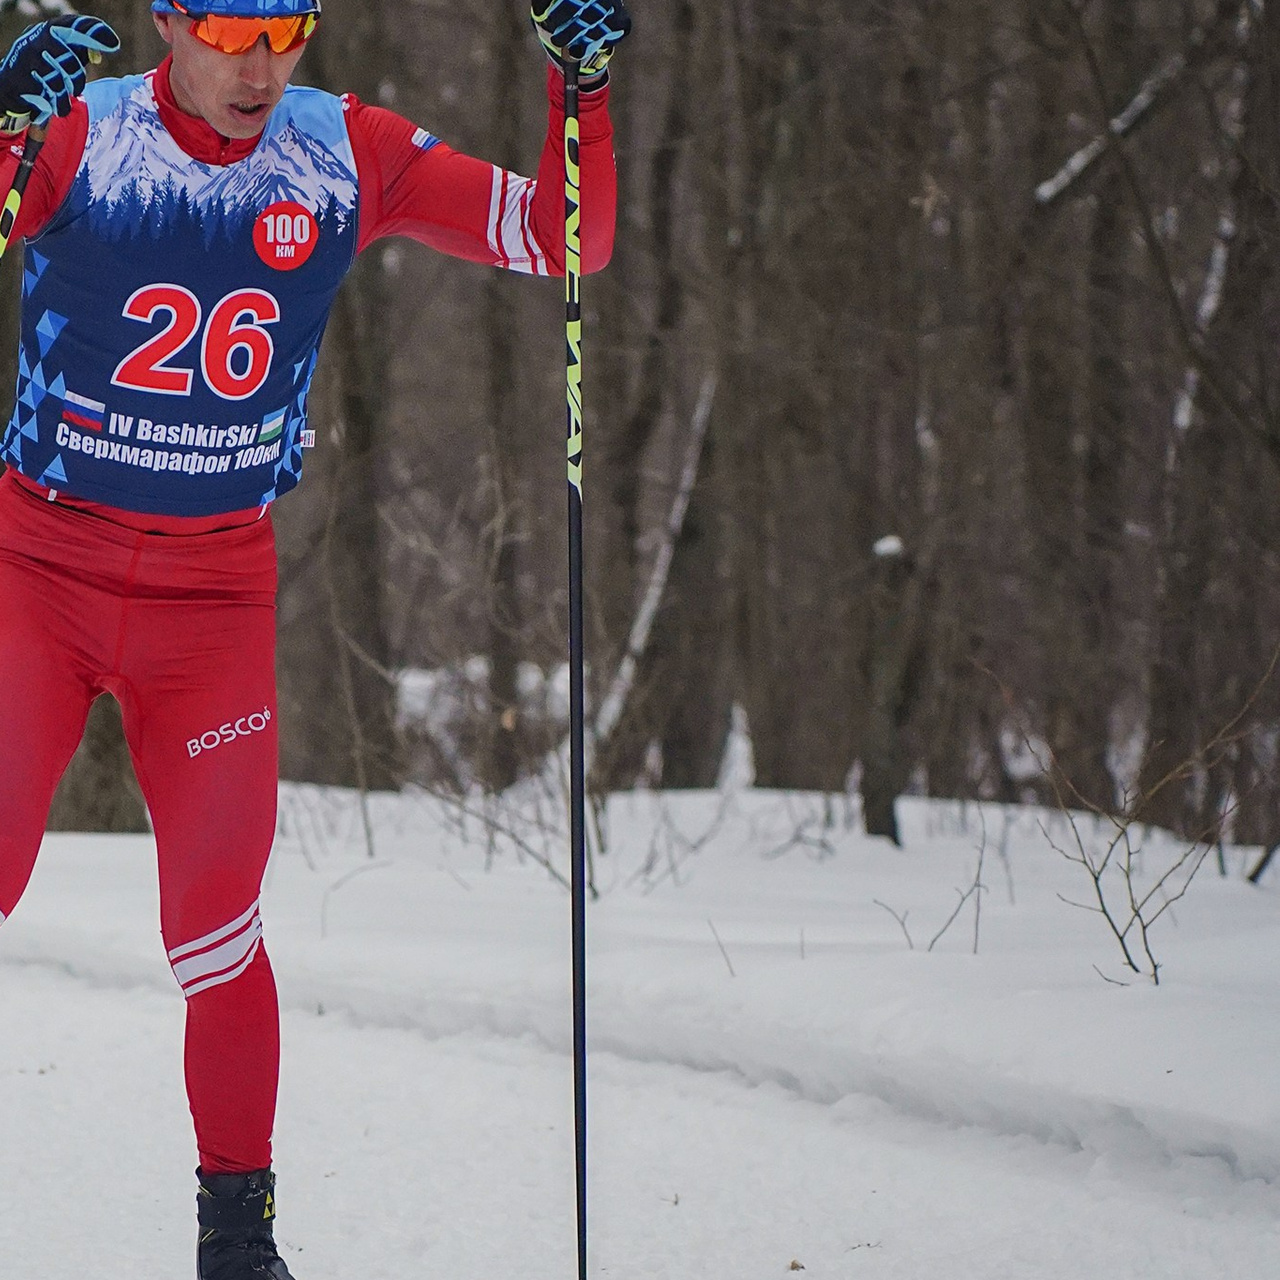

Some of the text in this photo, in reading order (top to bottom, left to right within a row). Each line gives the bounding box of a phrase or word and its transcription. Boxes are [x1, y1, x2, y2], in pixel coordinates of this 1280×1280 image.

[263, 214, 310, 244] 100
[110, 283, 281, 401] 26
[55, 422, 232, 475] Сверхмарафон
[109, 412, 258, 448] IV BashkirSki
[186, 713, 267, 759] BOSCO
